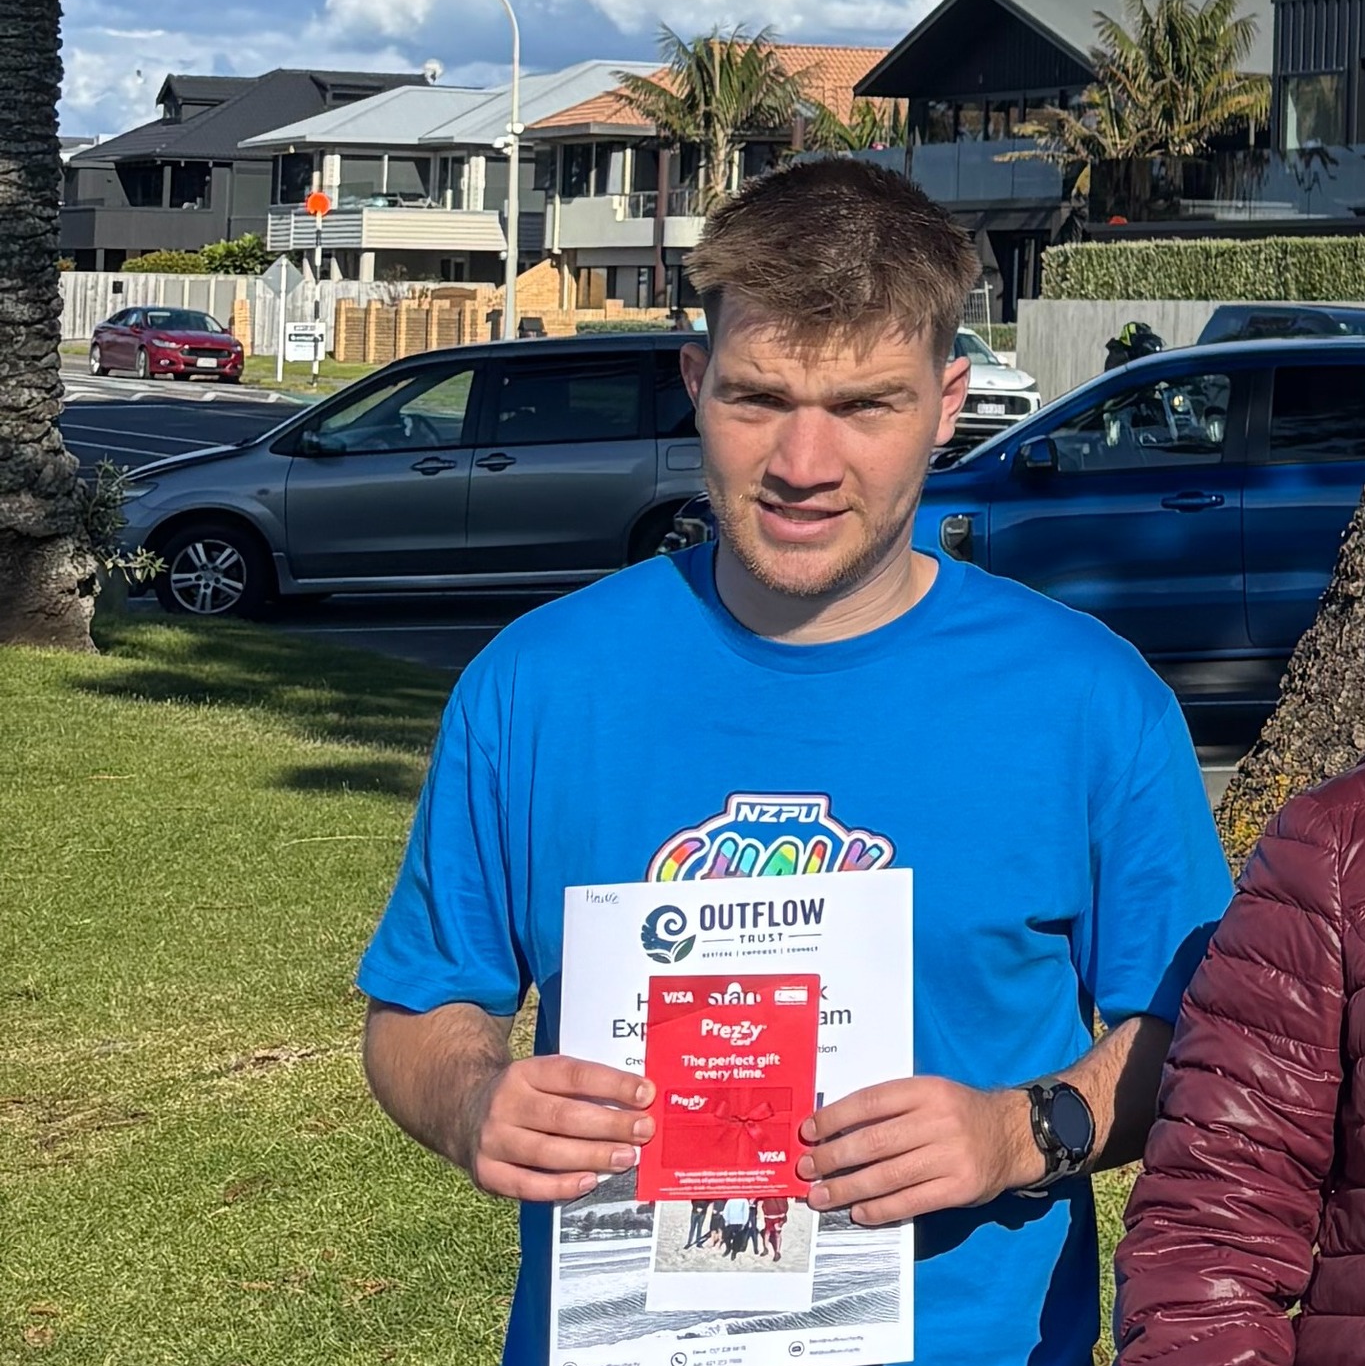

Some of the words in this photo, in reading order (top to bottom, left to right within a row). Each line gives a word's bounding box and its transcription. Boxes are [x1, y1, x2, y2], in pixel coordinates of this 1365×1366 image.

[736, 804, 820, 823] NZPU
[699, 897, 826, 932] OUTFLOW
[739, 932, 785, 945] TRUST
[662, 990, 694, 1004] VISA
[700, 1018, 762, 1042] Prezzy
[681, 1055, 706, 1067] The
[707, 1054, 755, 1070] perfect
[757, 1053, 781, 1069] gift
[694, 1069, 730, 1082] every
[733, 1066, 765, 1080] time.
[757, 1150, 786, 1163] VISA
